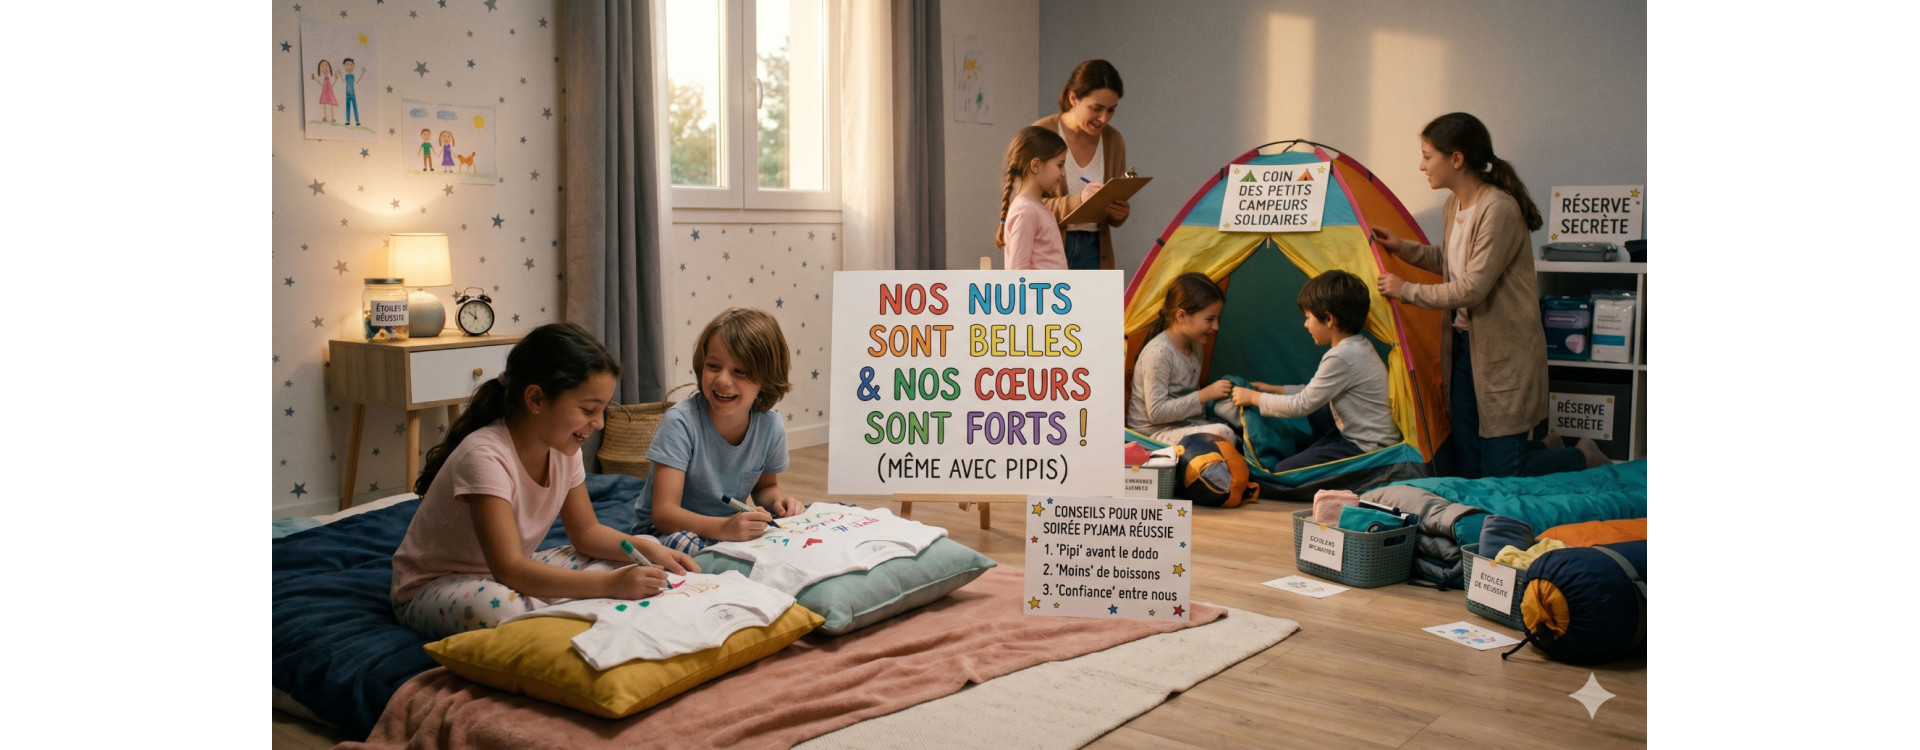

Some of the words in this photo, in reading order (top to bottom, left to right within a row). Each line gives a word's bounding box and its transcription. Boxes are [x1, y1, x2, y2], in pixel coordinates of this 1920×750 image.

[1262, 170, 1292, 182] COIN
[1239, 185, 1263, 196] DES
[1268, 184, 1312, 196] PETITS
[1238, 199, 1308, 211] CAMPEURS
[1562, 193, 1631, 213] RÉSERVE
[1234, 214, 1308, 226] SOLIDAIRES
[1561, 214, 1628, 234] SECRÈTE
[879, 283, 949, 315] NOS
[376, 303, 401, 312] ÉTOILES
[376, 313, 405, 322] RÉUSSITE
[867, 324, 954, 357] SONT
[969, 324, 1082, 357] BELLES
[857, 366, 881, 401] &
[893, 367, 961, 401] NOS
[974, 367, 1091, 401] CŒURS
[1557, 399, 1605, 416] RÉSERVE
[864, 410, 952, 445] SONT
[966, 411, 1067, 445] FORTS
[1557, 415, 1604, 431] SECRÈTE
[877, 452, 941, 483] (MÊME
[949, 458, 997, 479] AVEC
[1006, 454, 1068, 484] PIPIS)
[1054, 505, 1106, 519] CONSEILS
[1109, 507, 1137, 520] POUR
[1141, 508, 1163, 521] UNE
[1043, 520, 1080, 535] SOIRÉE
[1084, 524, 1126, 537] PYJAMA
[1130, 523, 1174, 539] RÉUSSIE
[1044, 544, 1053, 556] 1.
[1056, 544, 1083, 559] 'Pipi'
[1086, 547, 1116, 558] avant
[1119, 546, 1129, 558] le
[1132, 547, 1159, 560] dodo
[1043, 564, 1053, 576] 2.
[1056, 564, 1094, 578] 'Moins'
[1097, 566, 1110, 578] de
[1114, 567, 1160, 580] boissons
[1480, 572, 1504, 586] ÉTOILES
[1043, 584, 1052, 596] 3.
[1056, 584, 1115, 598] 'Confiance'
[1118, 587, 1148, 600] entre
[1152, 591, 1178, 601] nous
